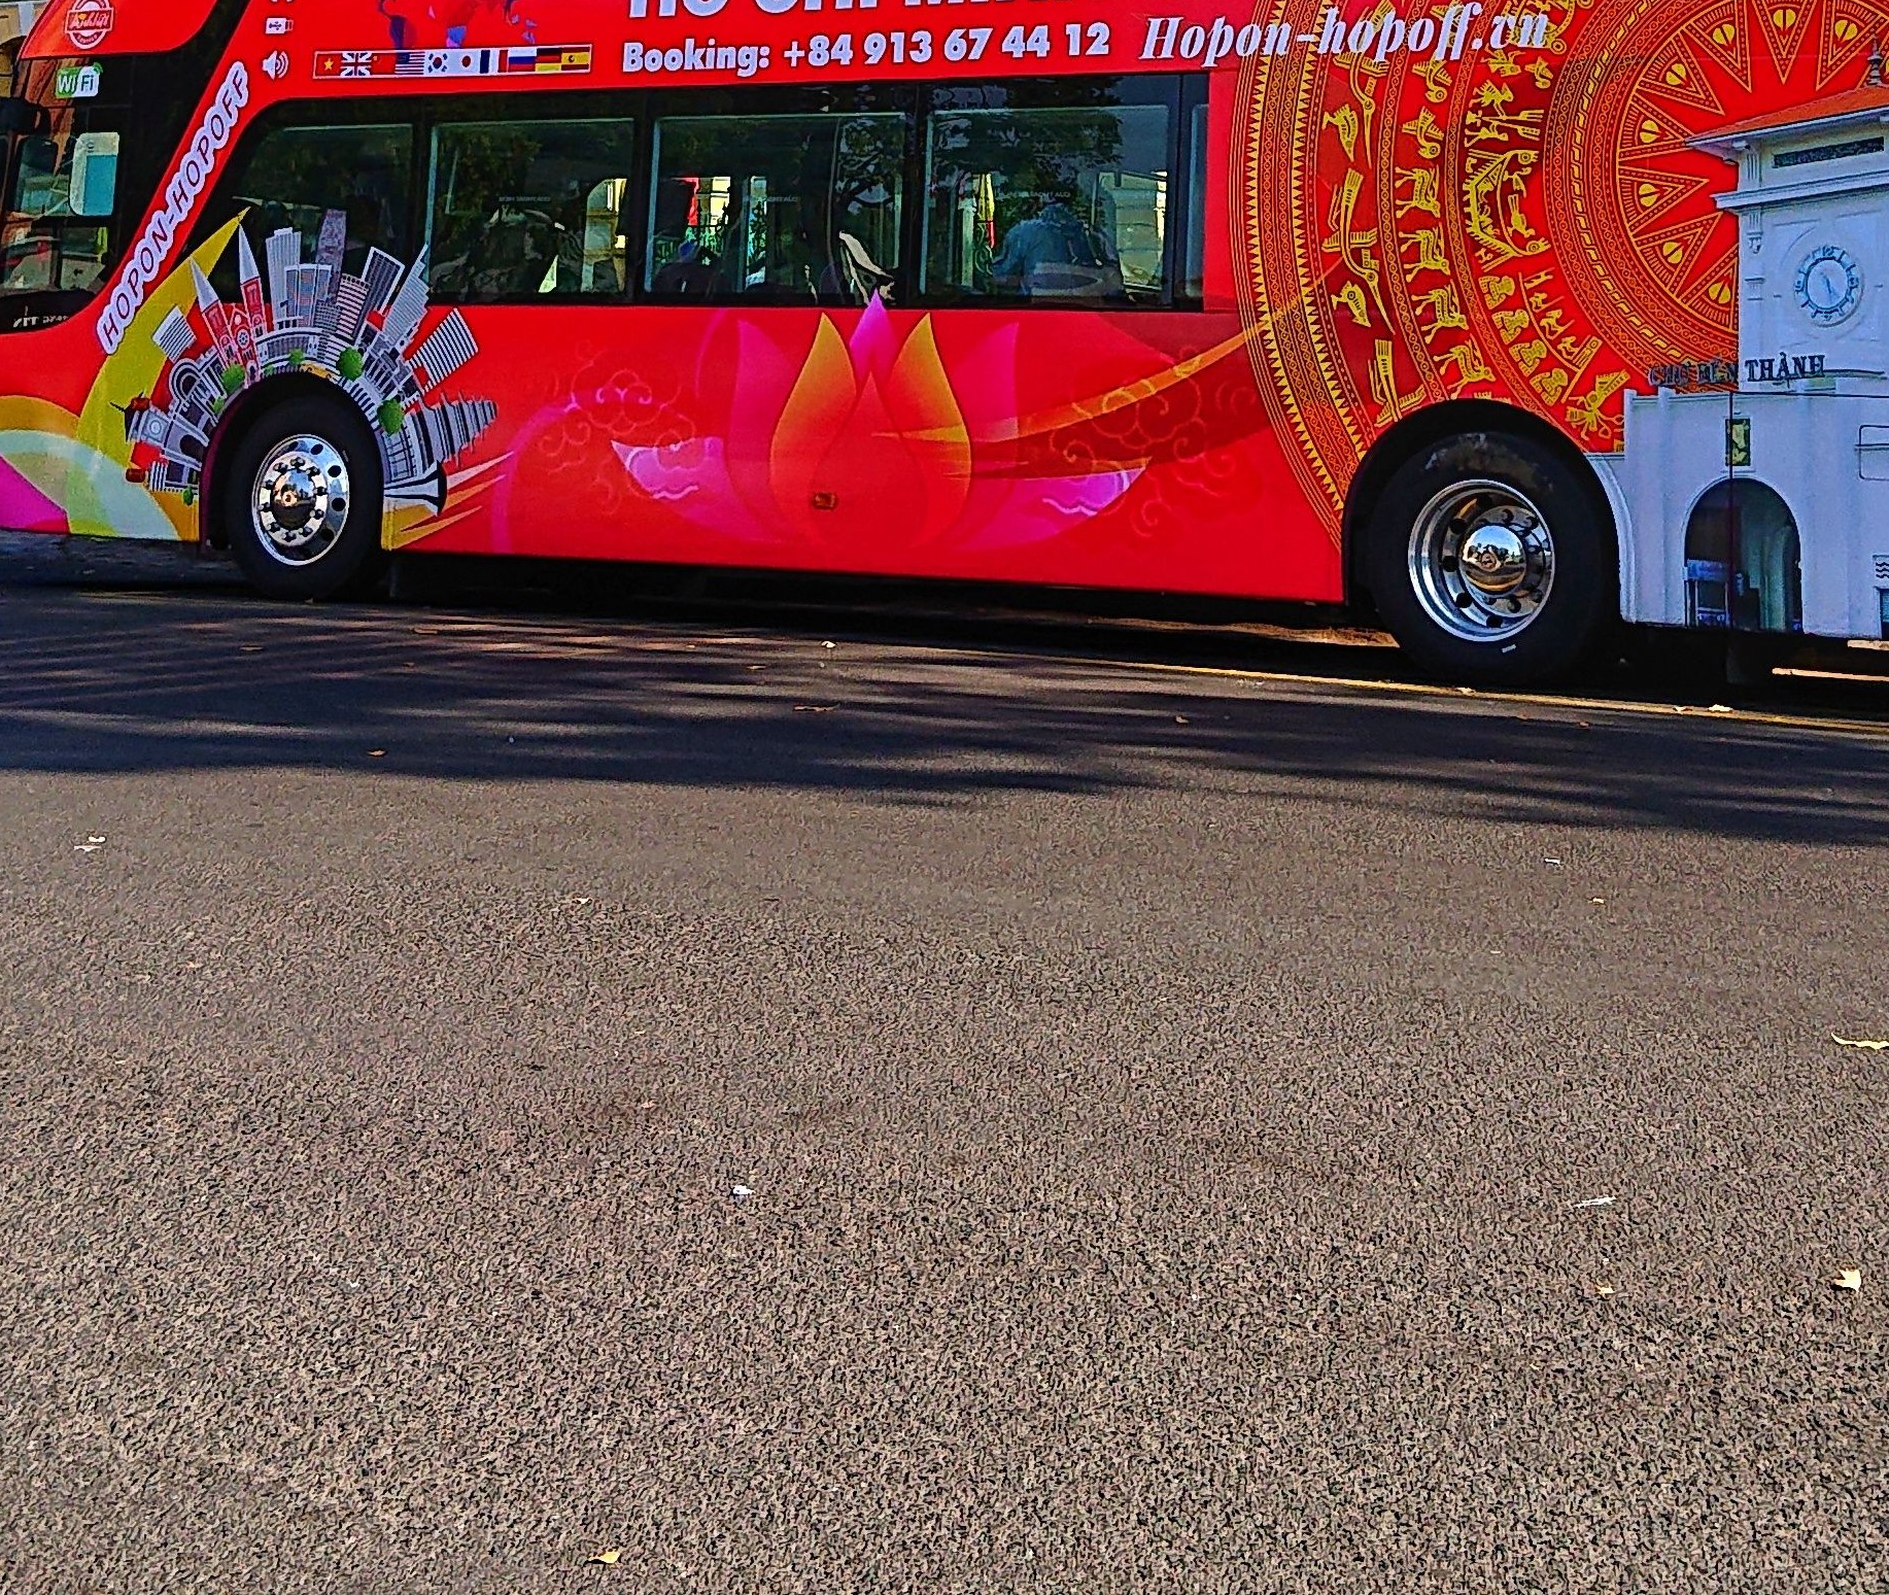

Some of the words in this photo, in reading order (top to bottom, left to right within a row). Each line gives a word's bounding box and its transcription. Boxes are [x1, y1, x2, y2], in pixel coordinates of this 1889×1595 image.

[622, 38, 771, 78] Booking:
[783, 34, 854, 68] +84
[864, 31, 933, 64] 913
[944, 27, 994, 61] 67
[1001, 25, 1051, 58] 44
[1066, 21, 1111, 56] 12
[1138, 1, 1550, 68] Hopon-hopoff.vn
[100, 64, 246, 351] HOPON-HOPOFF
[1745, 352, 1826, 382] THÀNH
